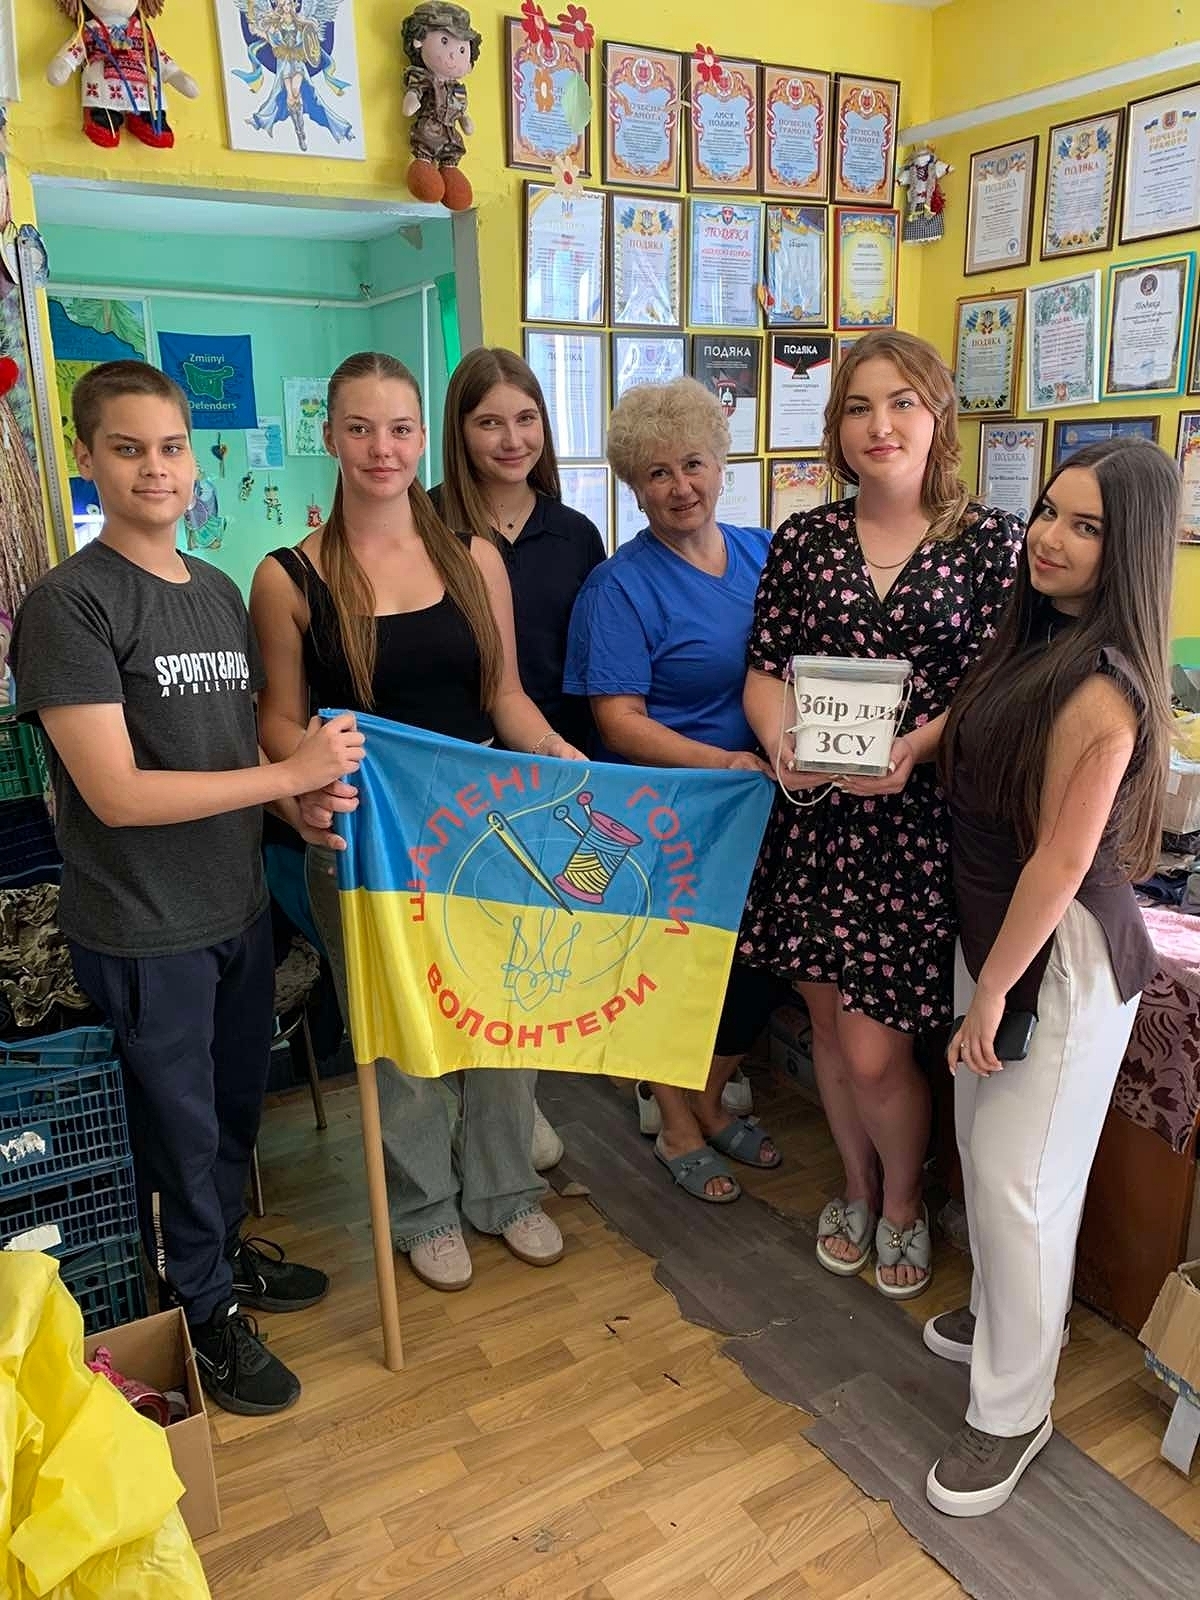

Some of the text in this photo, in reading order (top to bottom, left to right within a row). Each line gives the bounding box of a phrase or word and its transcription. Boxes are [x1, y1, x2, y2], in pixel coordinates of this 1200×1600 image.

[189, 353, 226, 365] Zmiinyi
[703, 346, 752, 358] ПОДЯКА
[783, 344, 819, 355] ПОДЯКА
[188, 401, 237, 410] Defenders
[161, 679, 248, 698] ATHLETIC
[799, 693, 849, 722] Збір
[815, 731, 876, 756] ЗСУ
[407, 764, 698, 936] ШАЛЕНІ ГОЛКИ
[427, 962, 658, 1050] ВОЛОНТЕРИ
